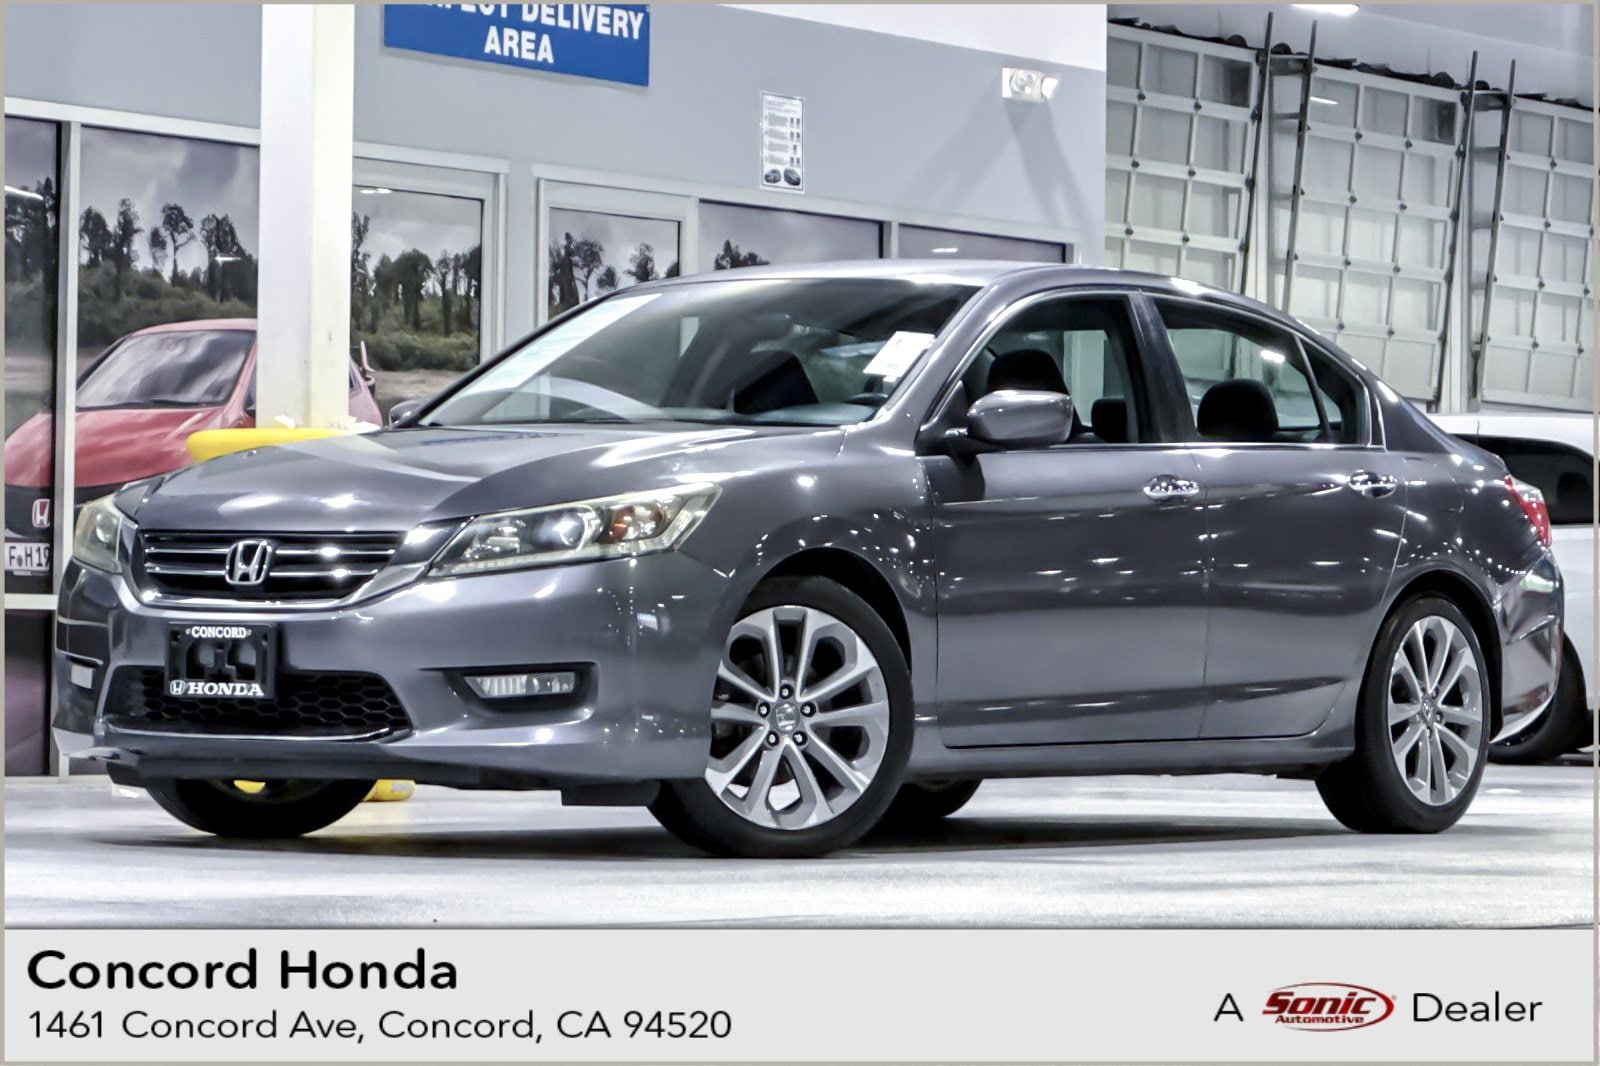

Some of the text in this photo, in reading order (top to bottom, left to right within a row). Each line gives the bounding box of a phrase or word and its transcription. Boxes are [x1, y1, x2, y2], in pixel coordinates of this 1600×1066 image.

[521, 3, 645, 40] DELIVERY
[484, 25, 555, 64] AREA
[191, 626, 247, 638] CONCORD
[187, 682, 265, 697] HONDA
